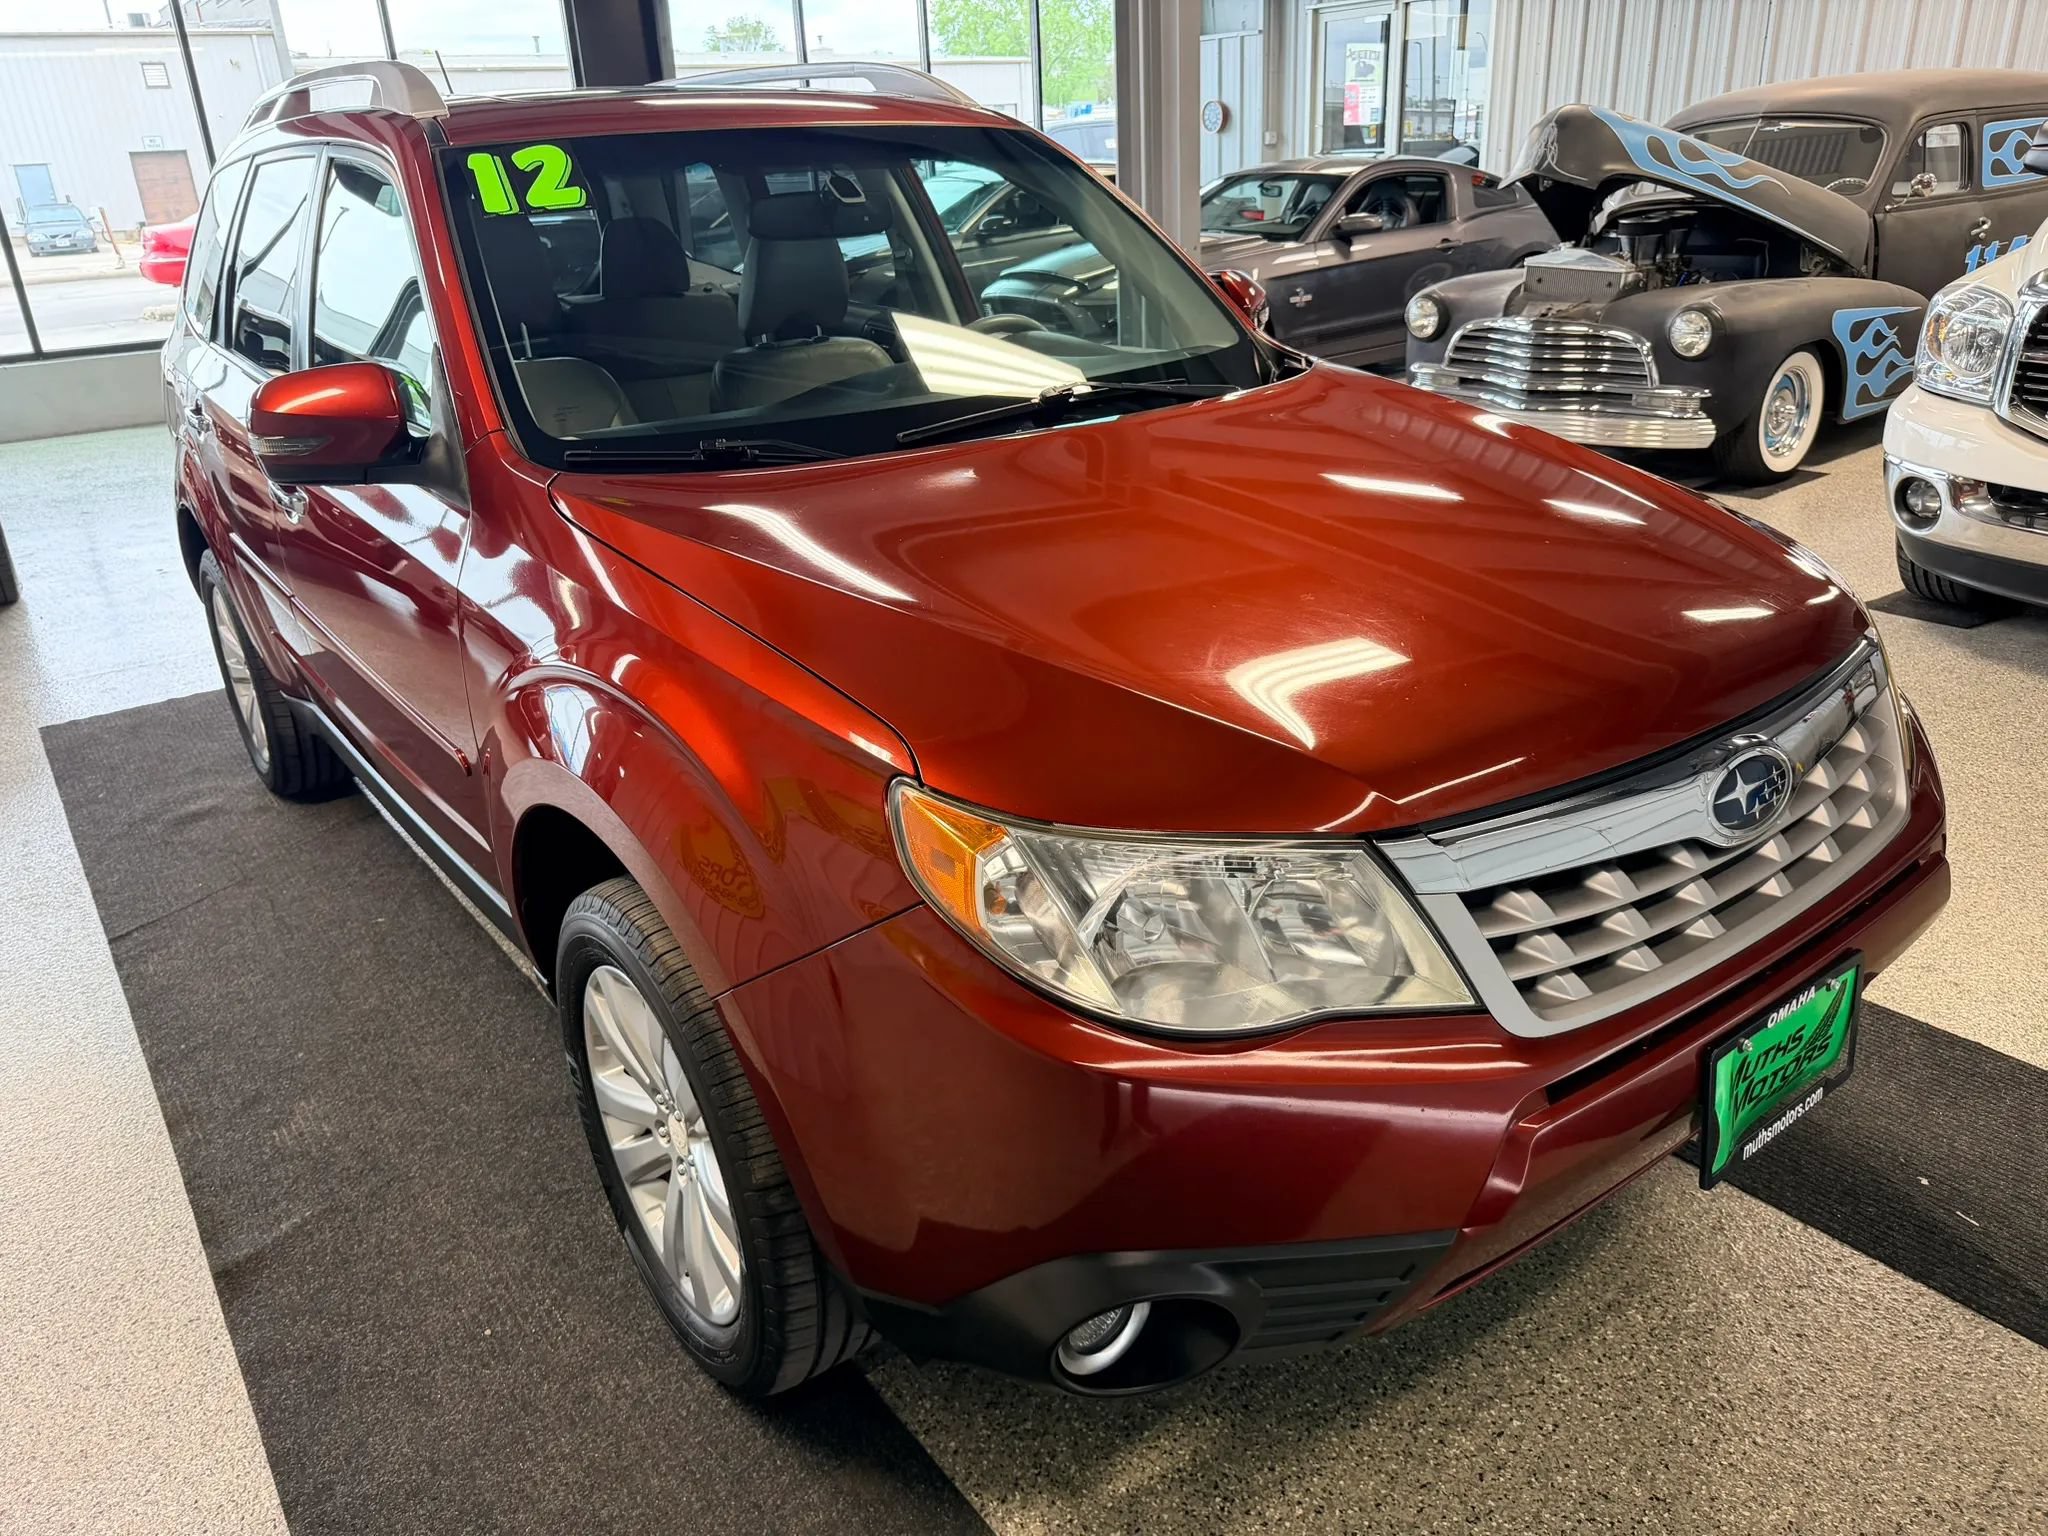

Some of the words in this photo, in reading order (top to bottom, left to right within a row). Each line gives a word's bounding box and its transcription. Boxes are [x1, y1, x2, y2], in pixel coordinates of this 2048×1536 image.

[466, 144, 587, 215] 12
[1767, 985, 1817, 1029] OMAHA
[1733, 1023, 1806, 1090] MUTHS
[1734, 1032, 1834, 1121] MOTORS
[1743, 1086, 1824, 1161] muthsmotors.com
